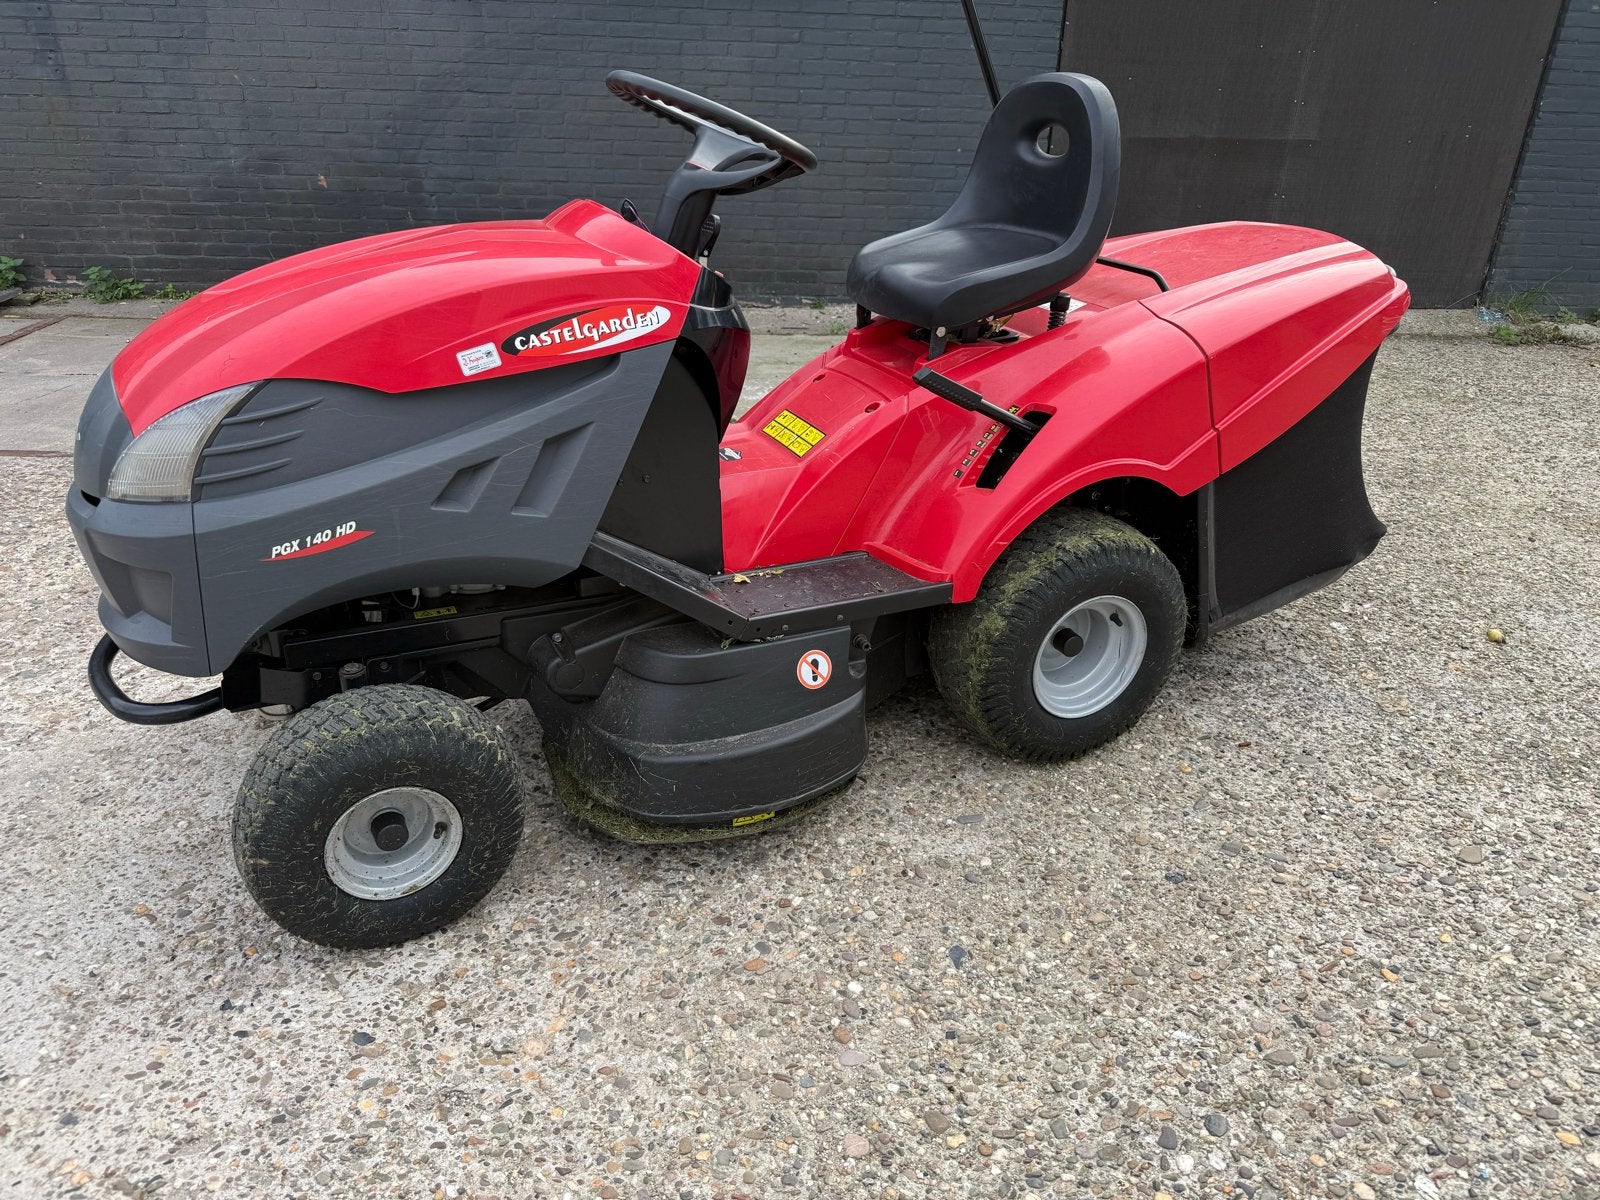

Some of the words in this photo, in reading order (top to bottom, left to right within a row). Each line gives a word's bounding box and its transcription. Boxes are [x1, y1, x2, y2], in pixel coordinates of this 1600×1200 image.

[514, 308, 660, 351] CASTELGARDEN
[271, 538, 300, 559] PGX
[305, 529, 332, 548] 140
[335, 521, 357, 538] HD
